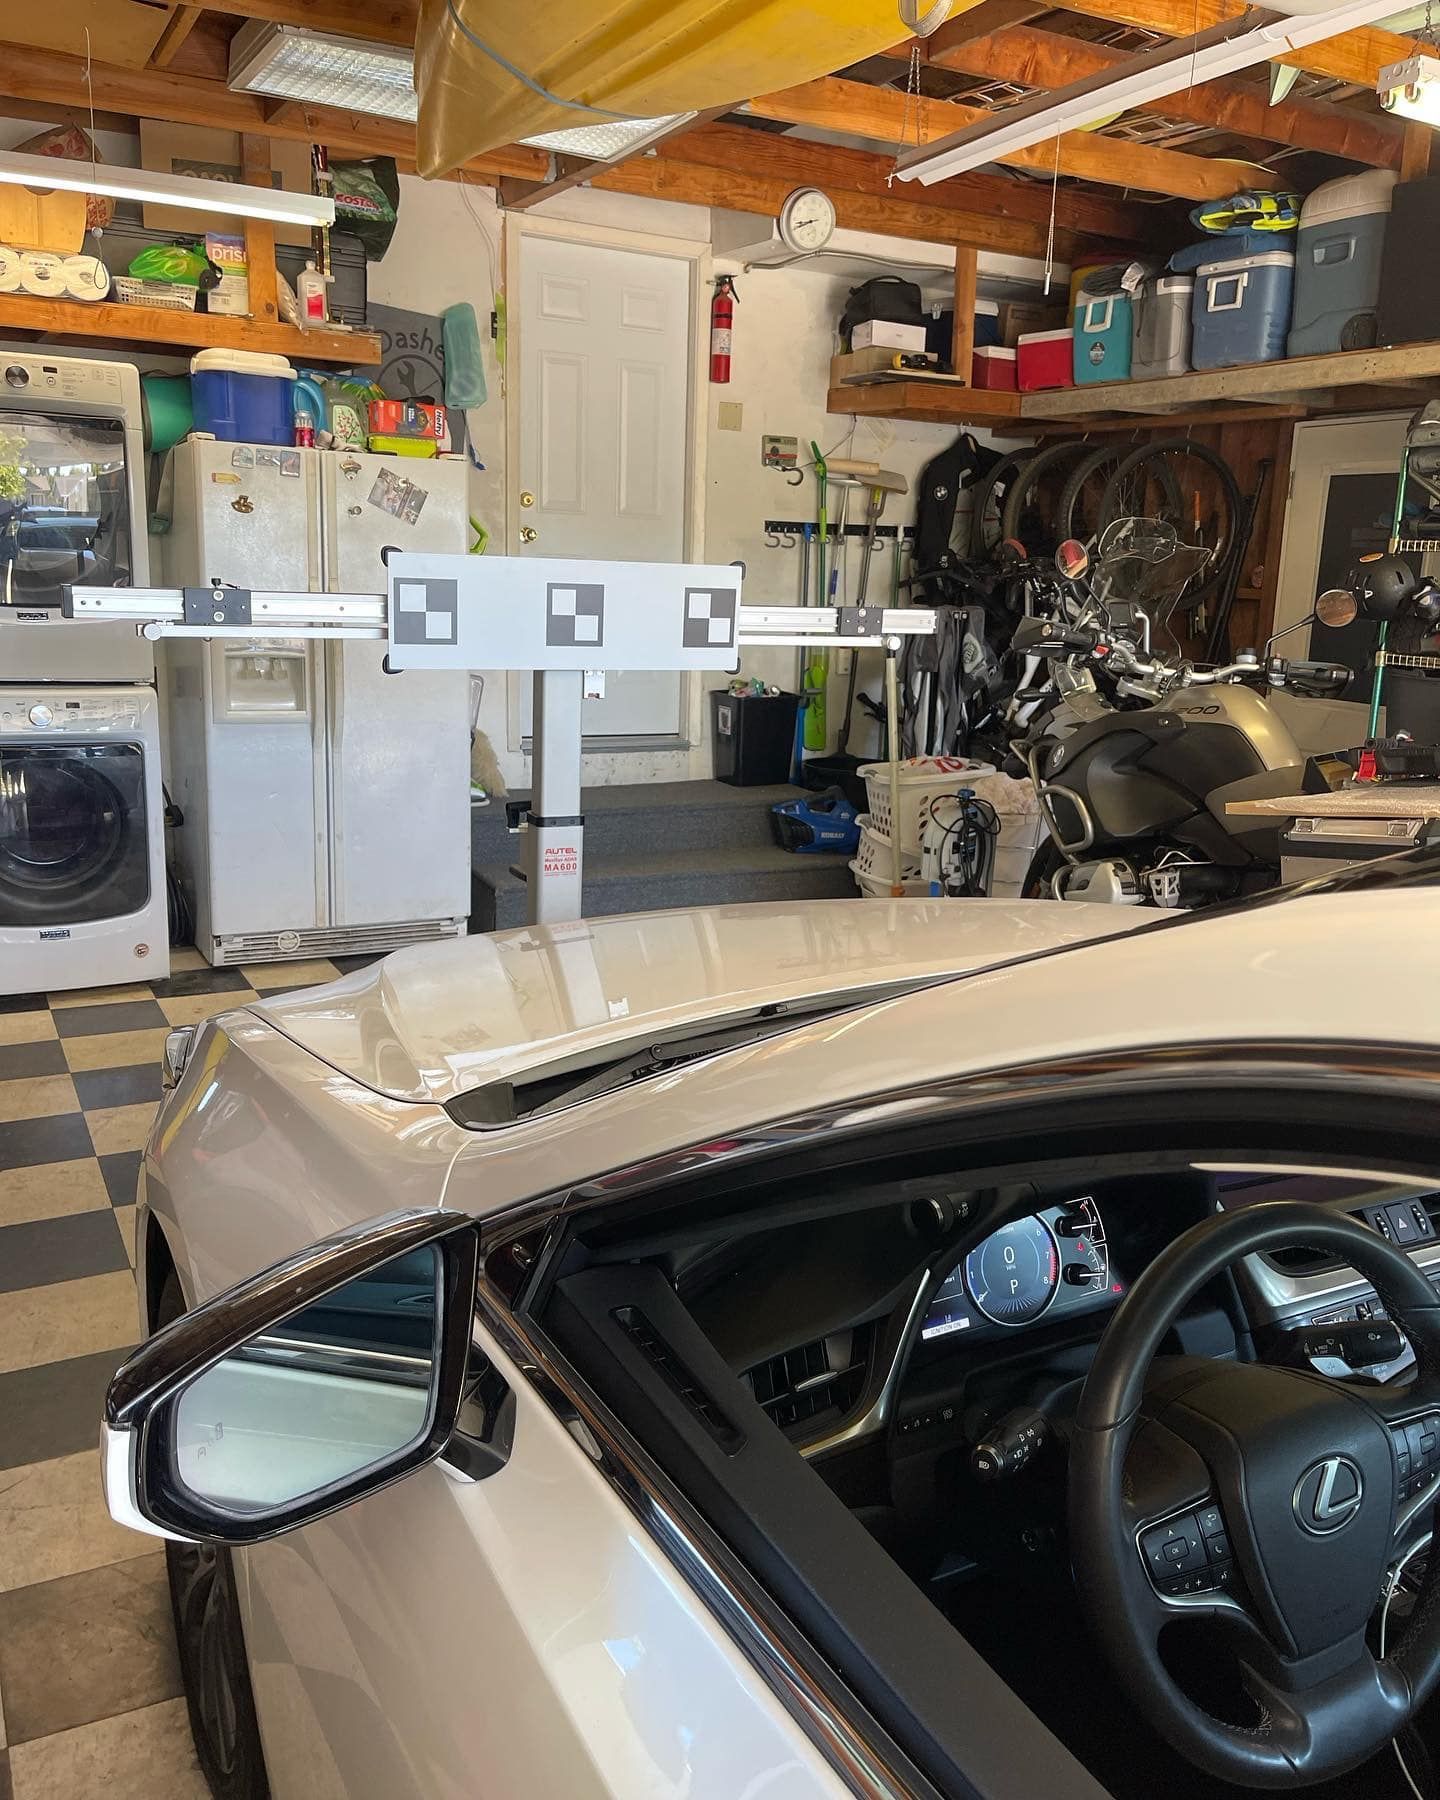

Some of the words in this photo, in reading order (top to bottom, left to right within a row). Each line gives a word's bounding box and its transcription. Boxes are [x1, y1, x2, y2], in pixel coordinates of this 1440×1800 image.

[211, 246, 247, 265] pris
[545, 847, 577, 855] AUTEL
[544, 863, 577, 871] MA600
[1003, 1246, 1015, 1264] 0
[1010, 1279, 1018, 1295] P
